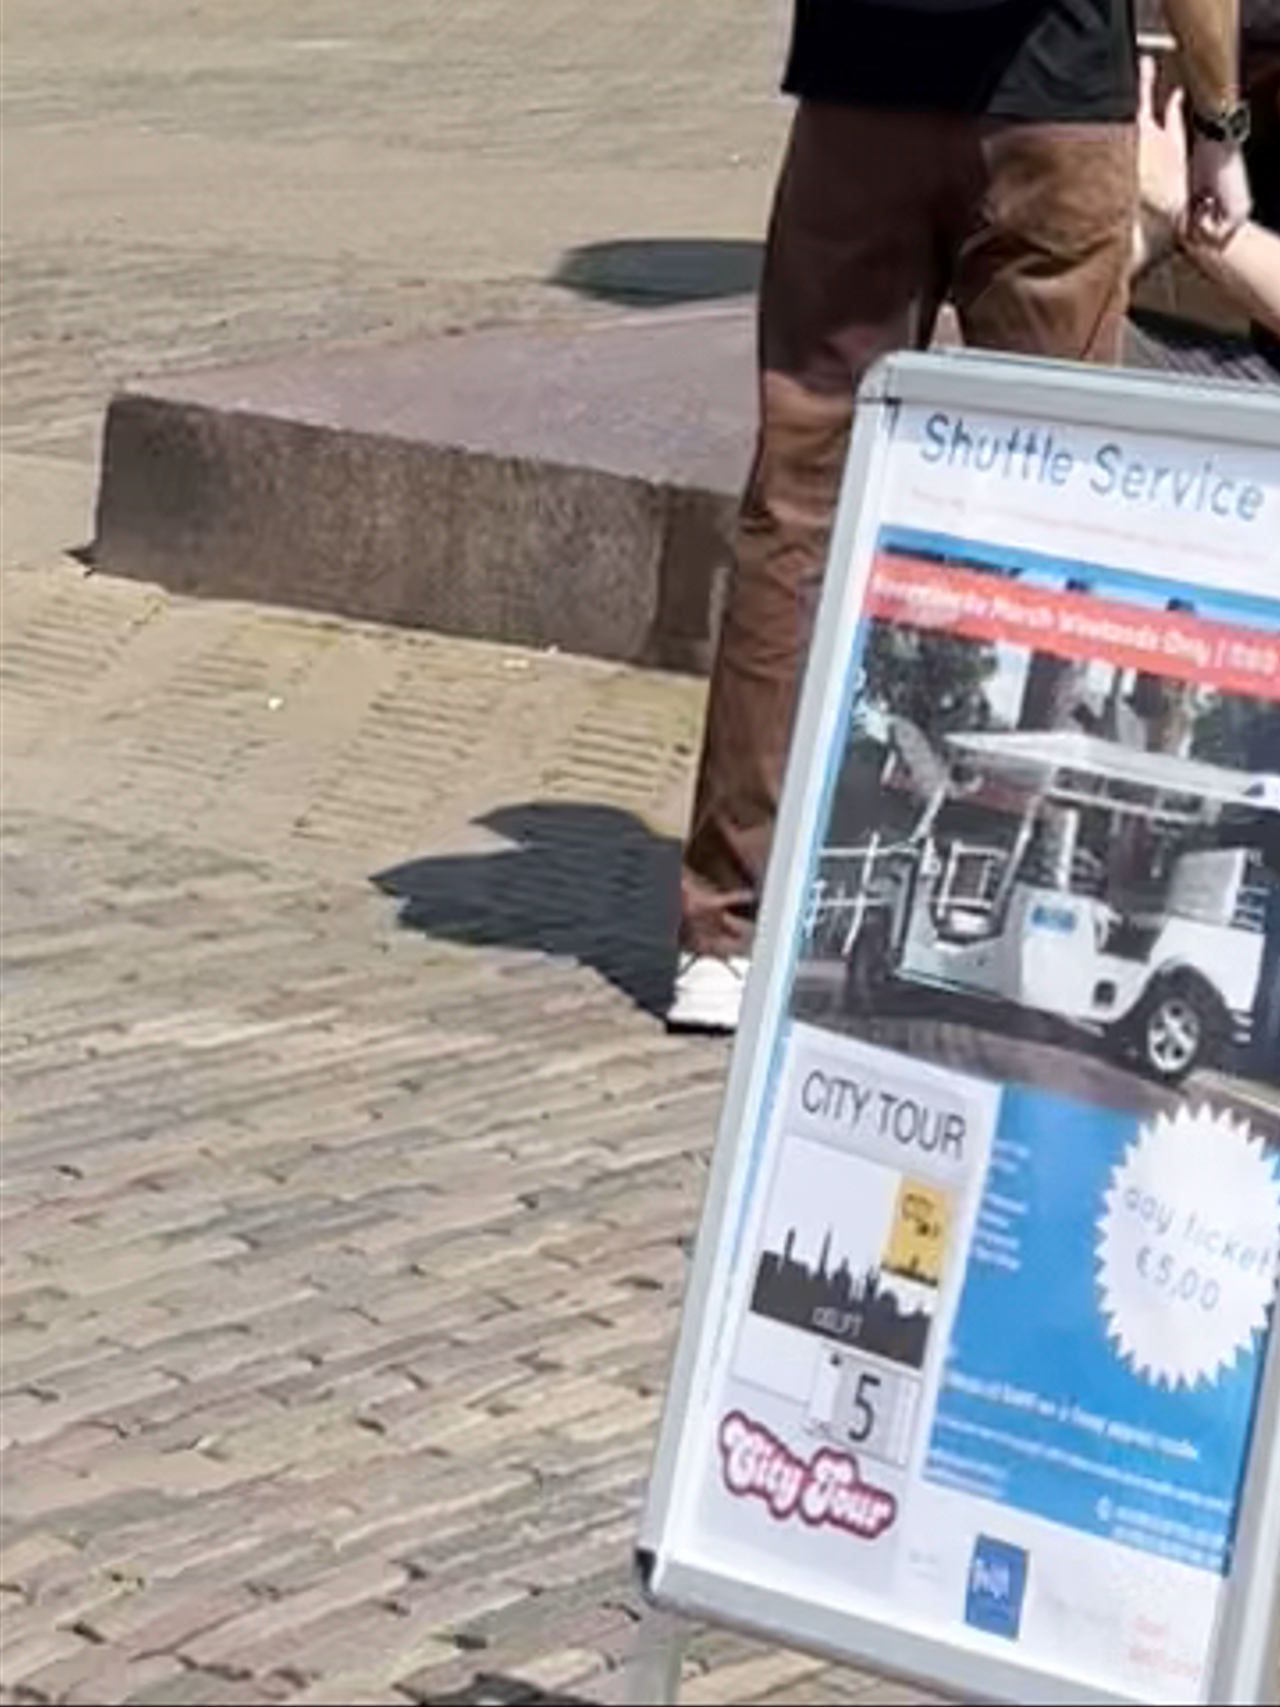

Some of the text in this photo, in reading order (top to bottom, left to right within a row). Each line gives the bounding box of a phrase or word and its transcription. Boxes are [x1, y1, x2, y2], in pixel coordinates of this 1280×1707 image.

[920, 412, 1264, 522] Shuttle Service
[802, 1069, 871, 1125] CITY
[878, 1090, 967, 1161] TOUR
[1134, 1246, 1220, 1311] €5,00
[848, 1373, 881, 1443] 5
[722, 1416, 806, 1516] City
[801, 1453, 894, 1534] Tour
